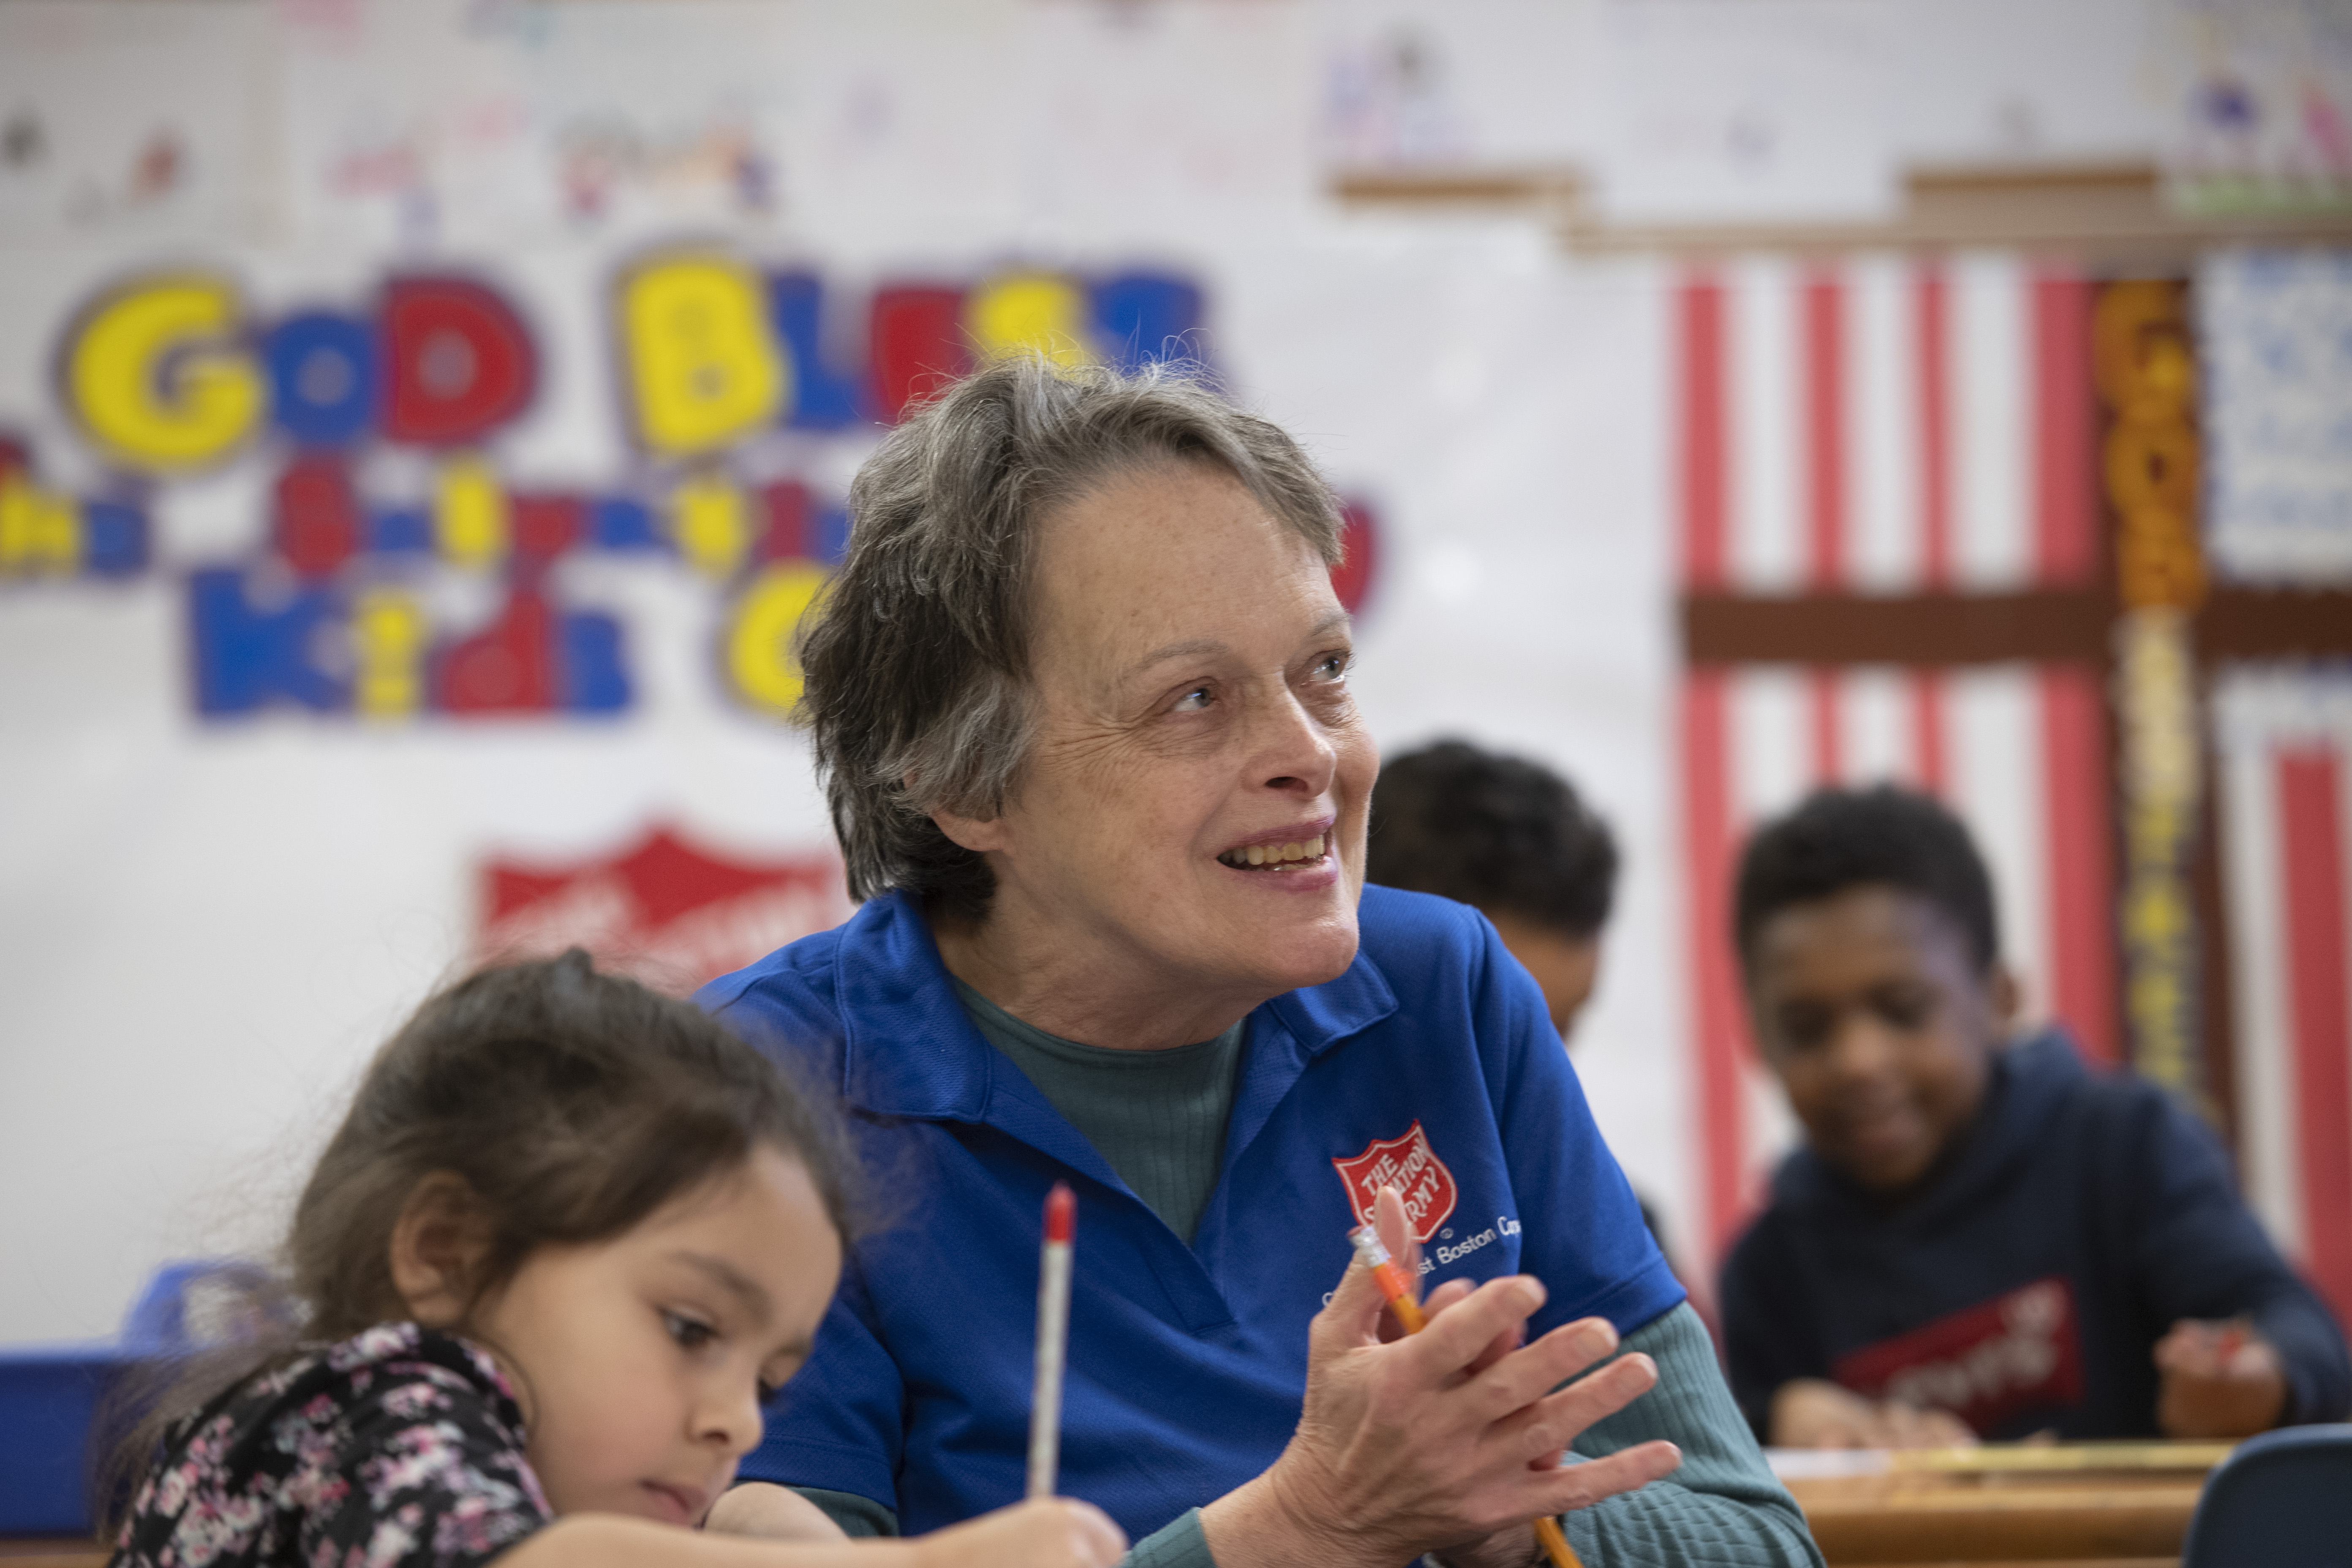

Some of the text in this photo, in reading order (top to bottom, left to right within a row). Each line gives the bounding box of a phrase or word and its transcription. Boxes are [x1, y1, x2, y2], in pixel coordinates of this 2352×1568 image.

[1361, 1153, 1398, 1196] THE
[1363, 1138, 1427, 1221] SATION
[1404, 1165, 1440, 1225] RMY
[1417, 1256, 1436, 1276] st
[1436, 1228, 1497, 1264] Boston
